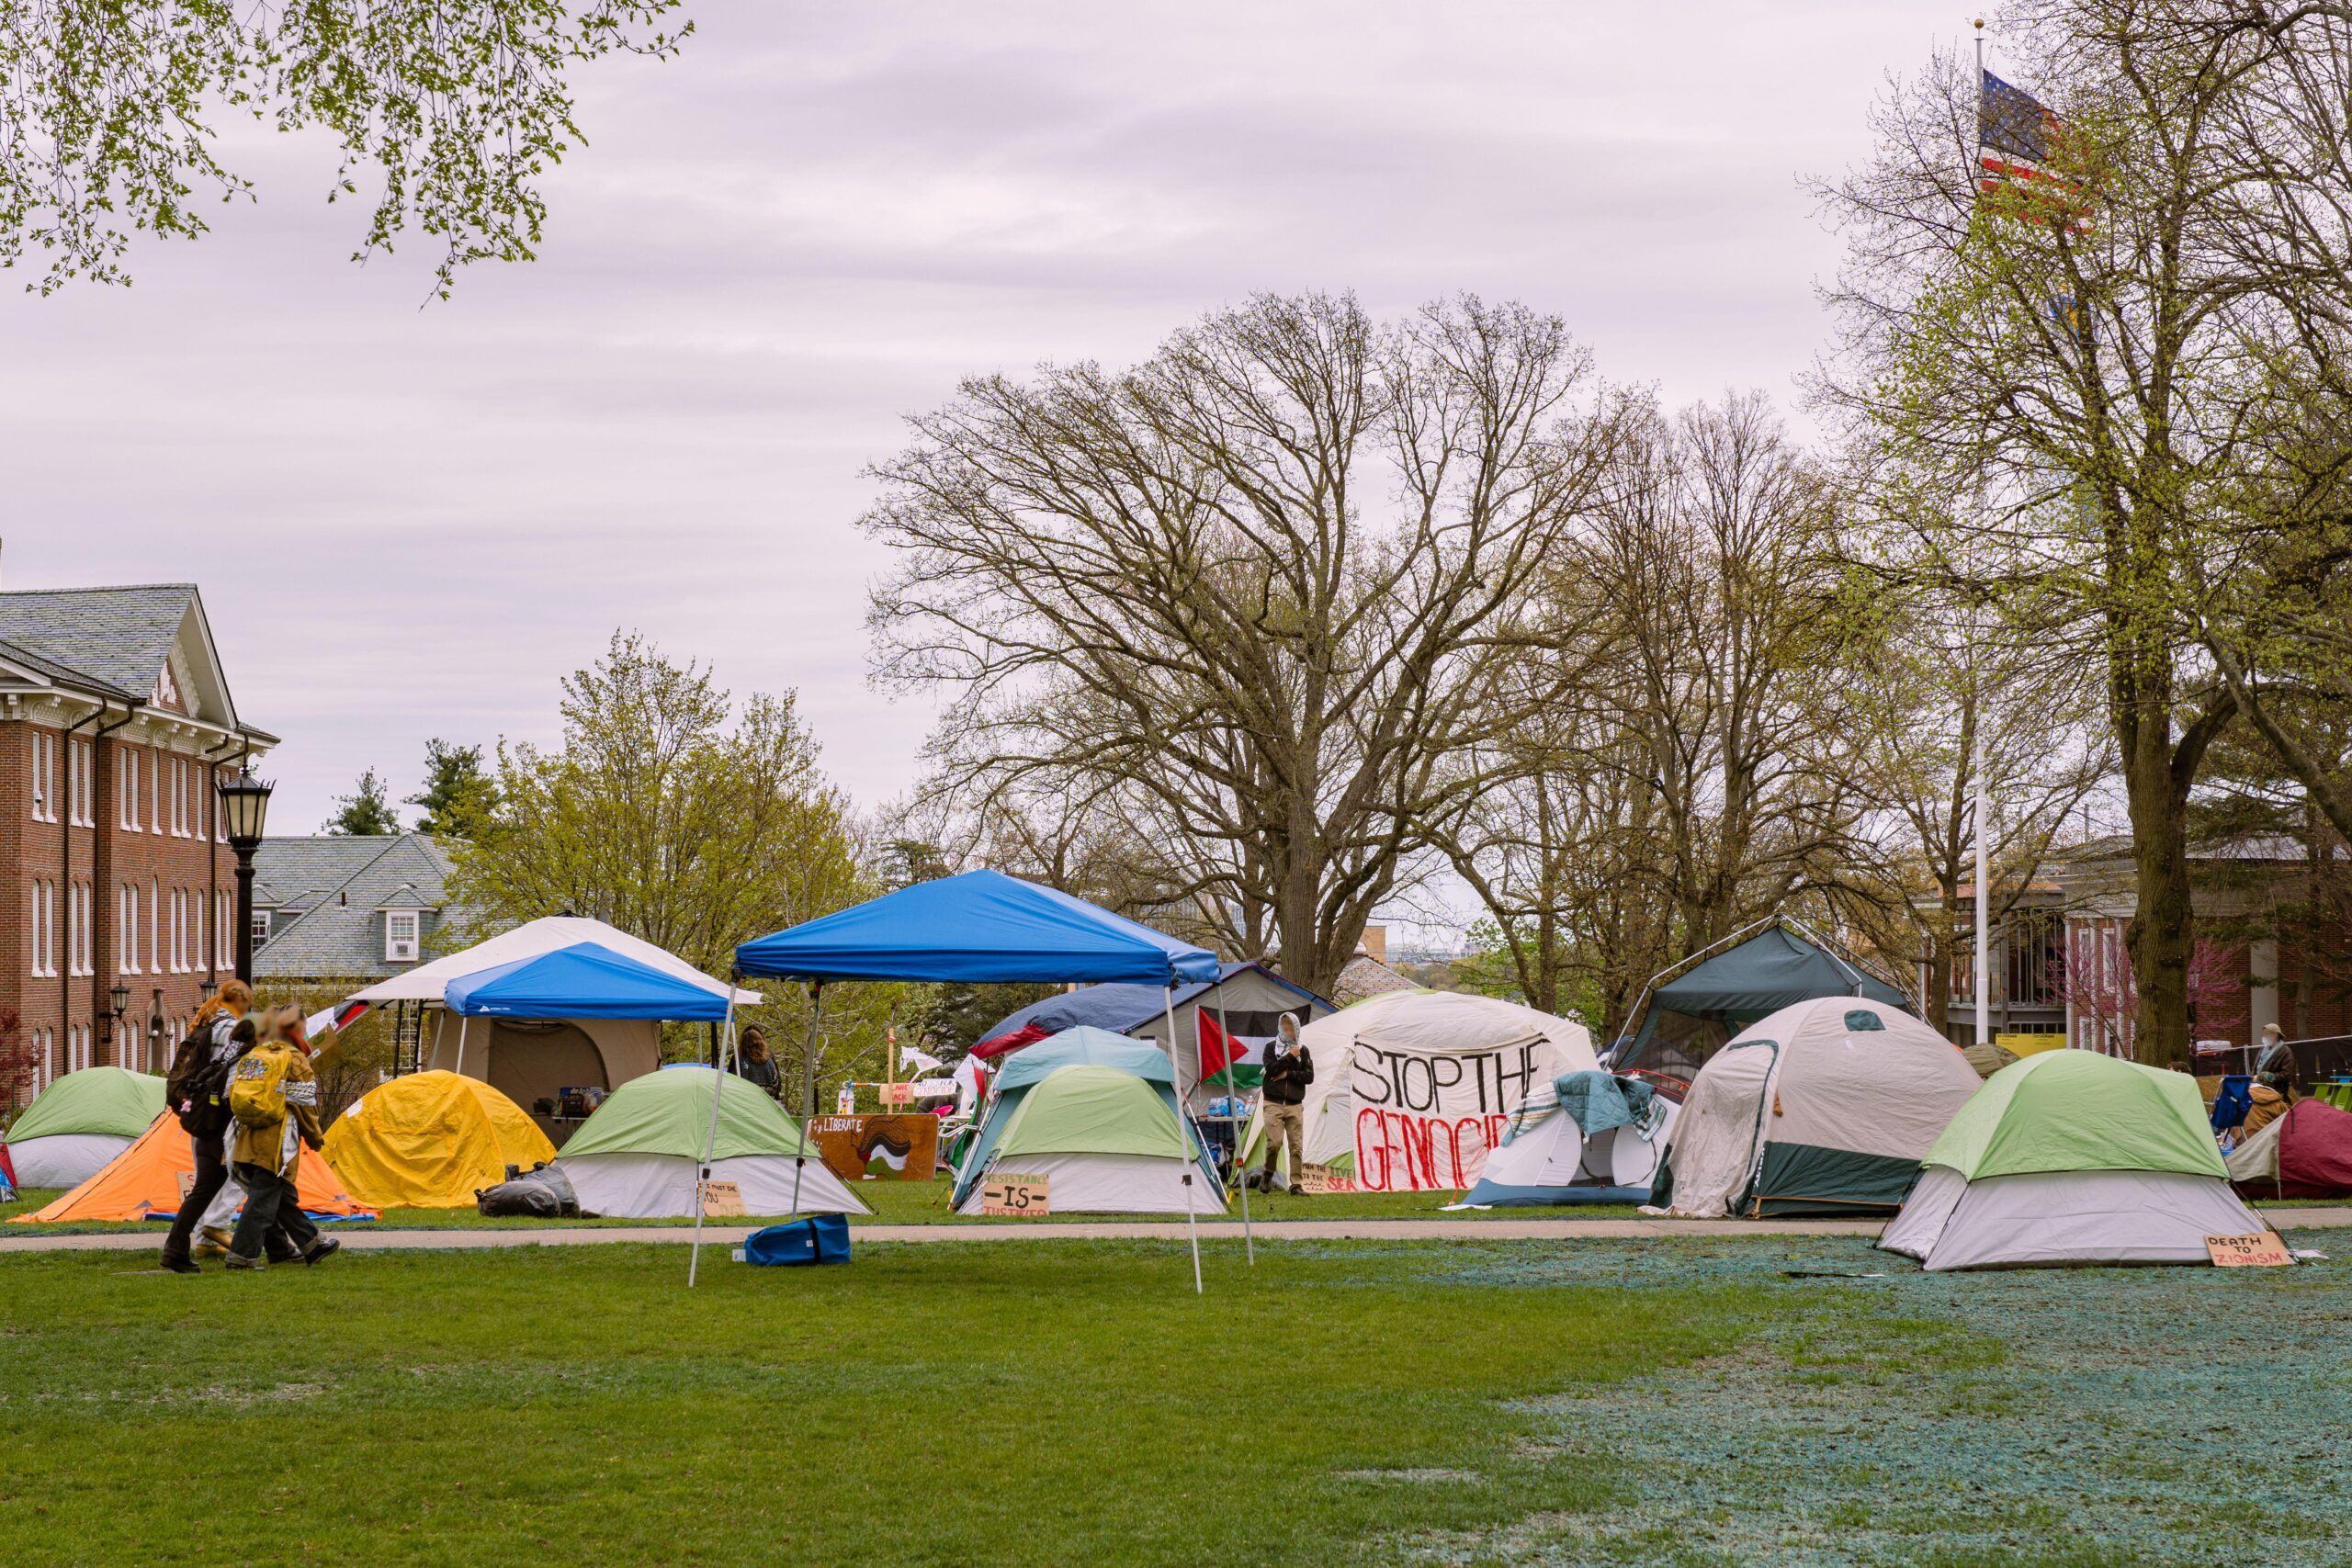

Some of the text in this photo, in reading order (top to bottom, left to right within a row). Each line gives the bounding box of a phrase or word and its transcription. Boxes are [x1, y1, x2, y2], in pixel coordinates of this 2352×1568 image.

[1352, 1042, 1463, 1114] STOP
[823, 1116, 863, 1133] LIBERATE
[1316, 1164, 1327, 1173] THE
[984, 1173, 1047, 1185] RESISTANCE
[1327, 1176, 1358, 1191] SEA
[701, 1191, 719, 1204] OU
[2208, 1236, 2262, 1246] DEATH
[2233, 1246, 2252, 1254] TO
[2214, 1252, 2282, 1264] ZIONISM
